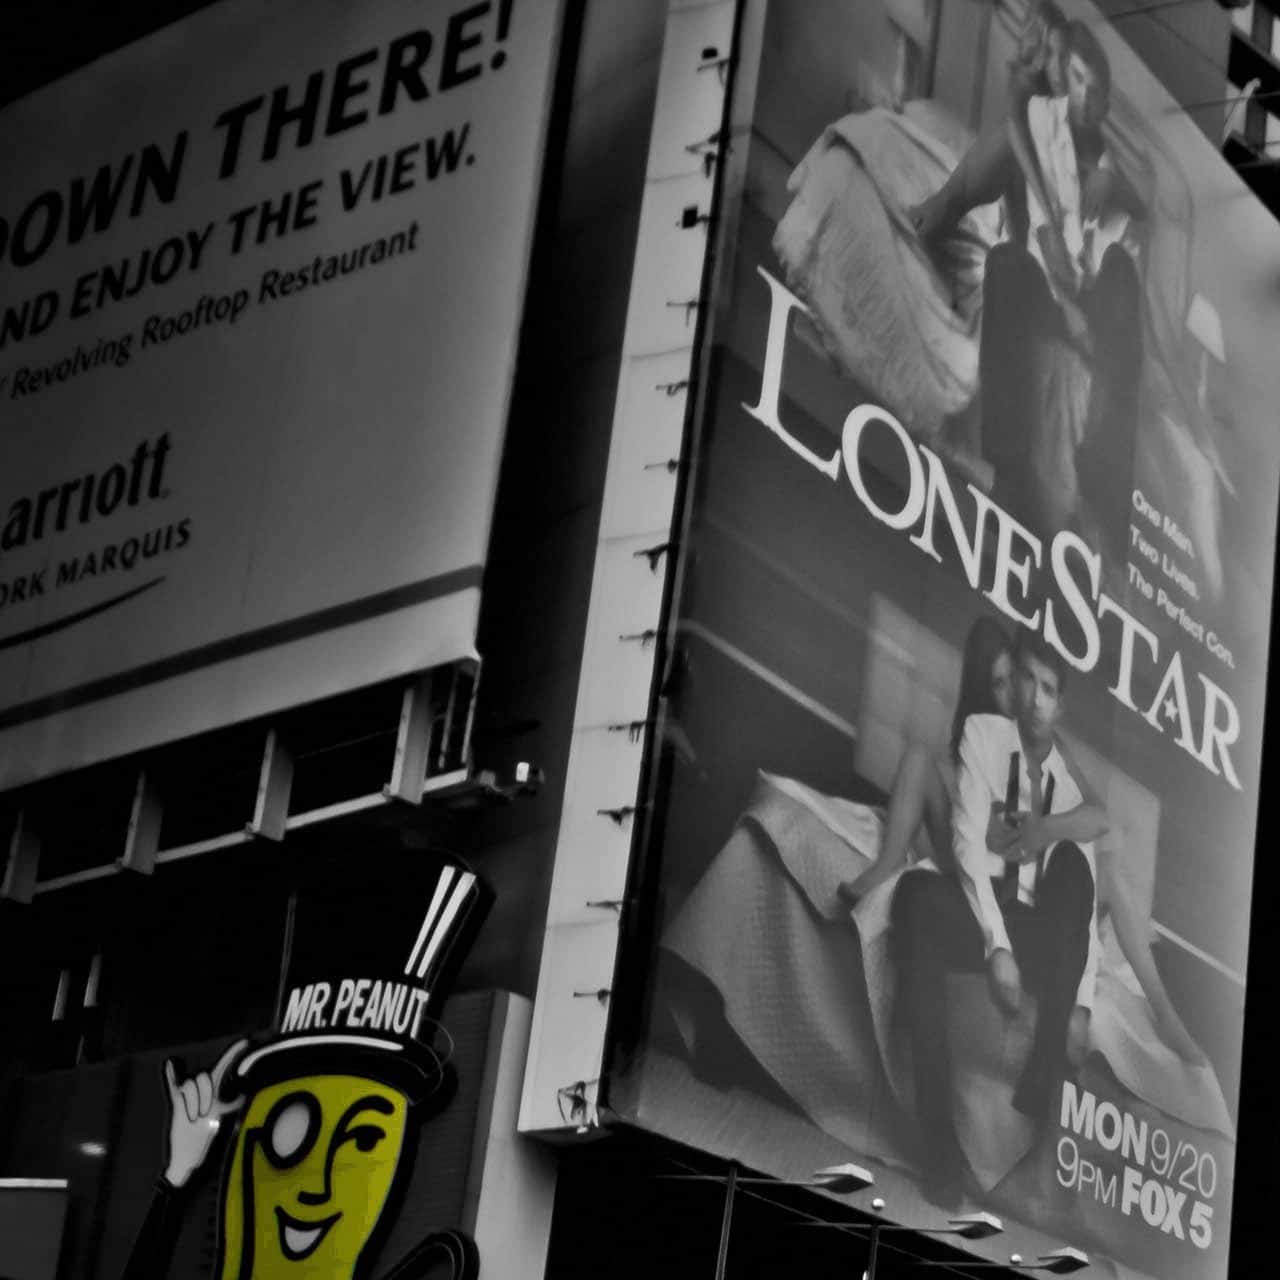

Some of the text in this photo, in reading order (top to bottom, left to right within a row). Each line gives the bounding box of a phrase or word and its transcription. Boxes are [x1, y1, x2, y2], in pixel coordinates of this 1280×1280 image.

[214, 0, 512, 180] THERE!
[70, 222, 212, 320] ENJOY
[228, 181, 323, 255] THE
[338, 124, 477, 213] VIEW.
[11, 220, 420, 399] Revolving Rooftop Restaurant
[1132, 489, 1161, 527] One
[56, 517, 191, 586] MARQUIS
[1127, 562, 1154, 599] The
[1129, 524, 1160, 565] Two
[280, 978, 430, 1038] MR. PEANUT
[1056, 1135, 1117, 1210] 9PM
[1059, 1080, 1218, 1200] MON 9/20
